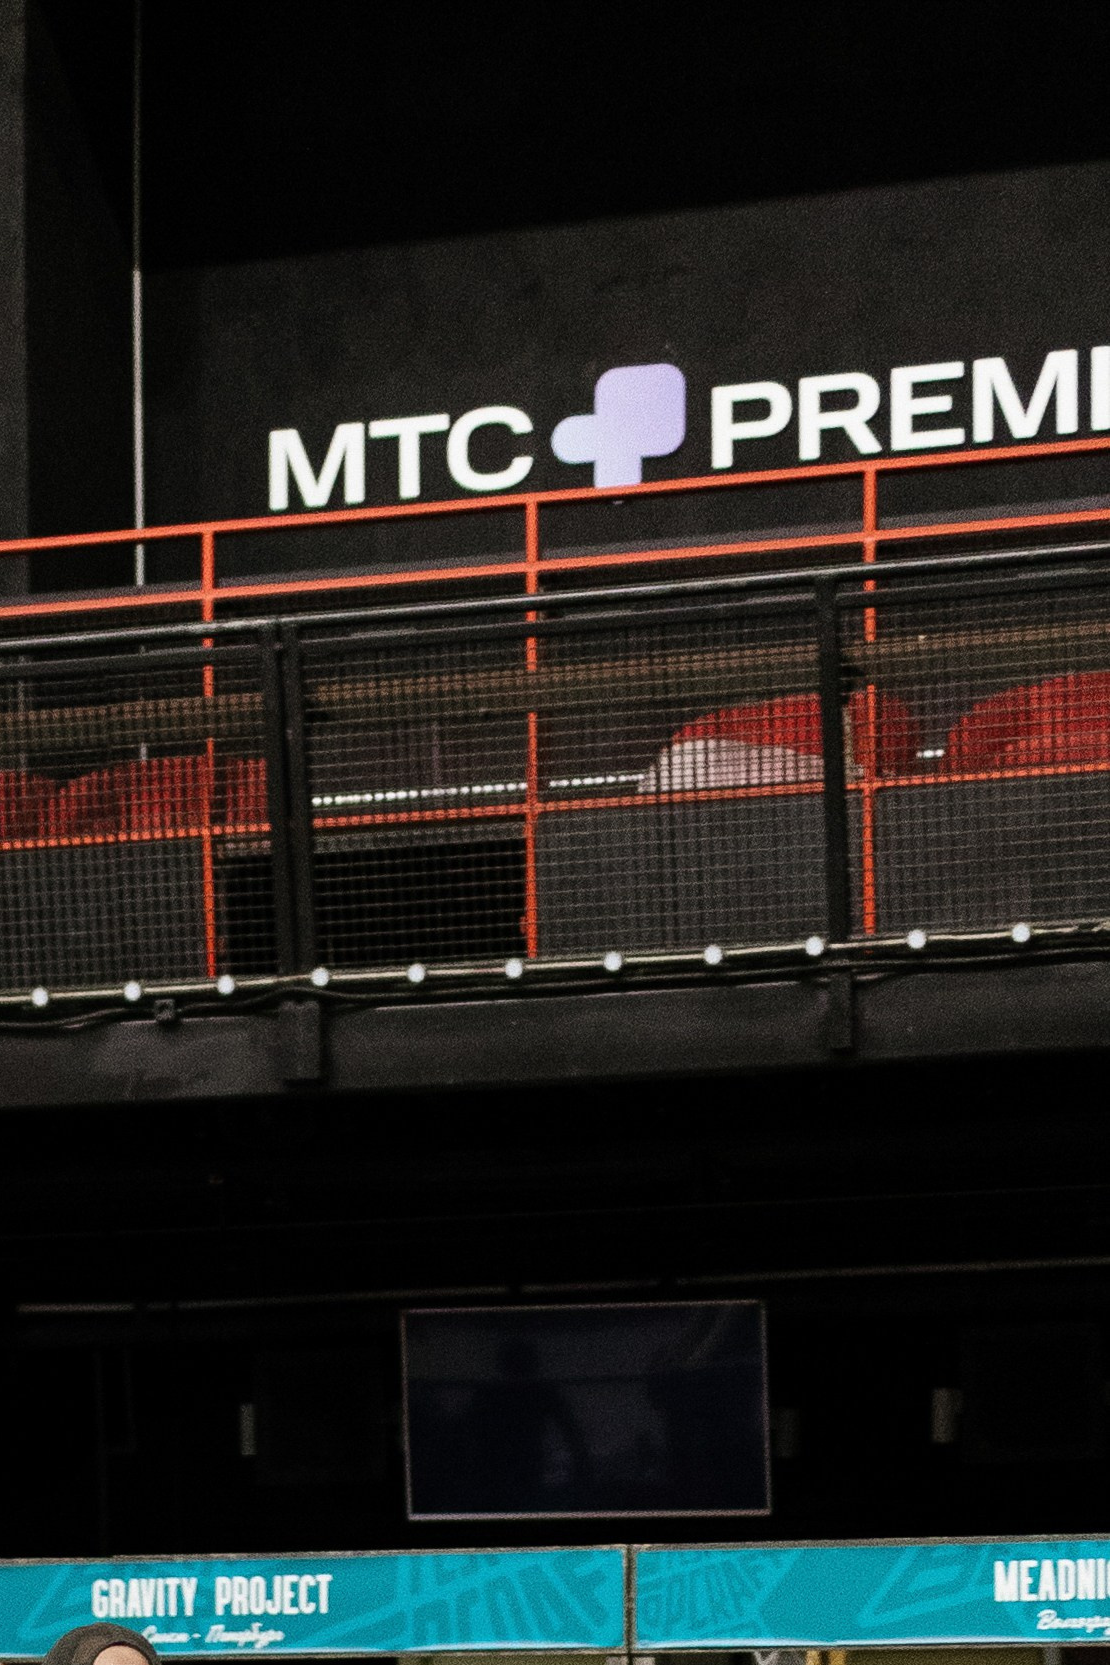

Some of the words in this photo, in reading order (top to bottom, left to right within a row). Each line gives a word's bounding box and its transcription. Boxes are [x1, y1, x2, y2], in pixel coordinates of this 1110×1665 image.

[268, 406, 534, 511] MTC
[92, 1577, 198, 1618] GRAVITY
[215, 1574, 333, 1616] PROJECT
[994, 1558, 1110, 1602] MEADNI
